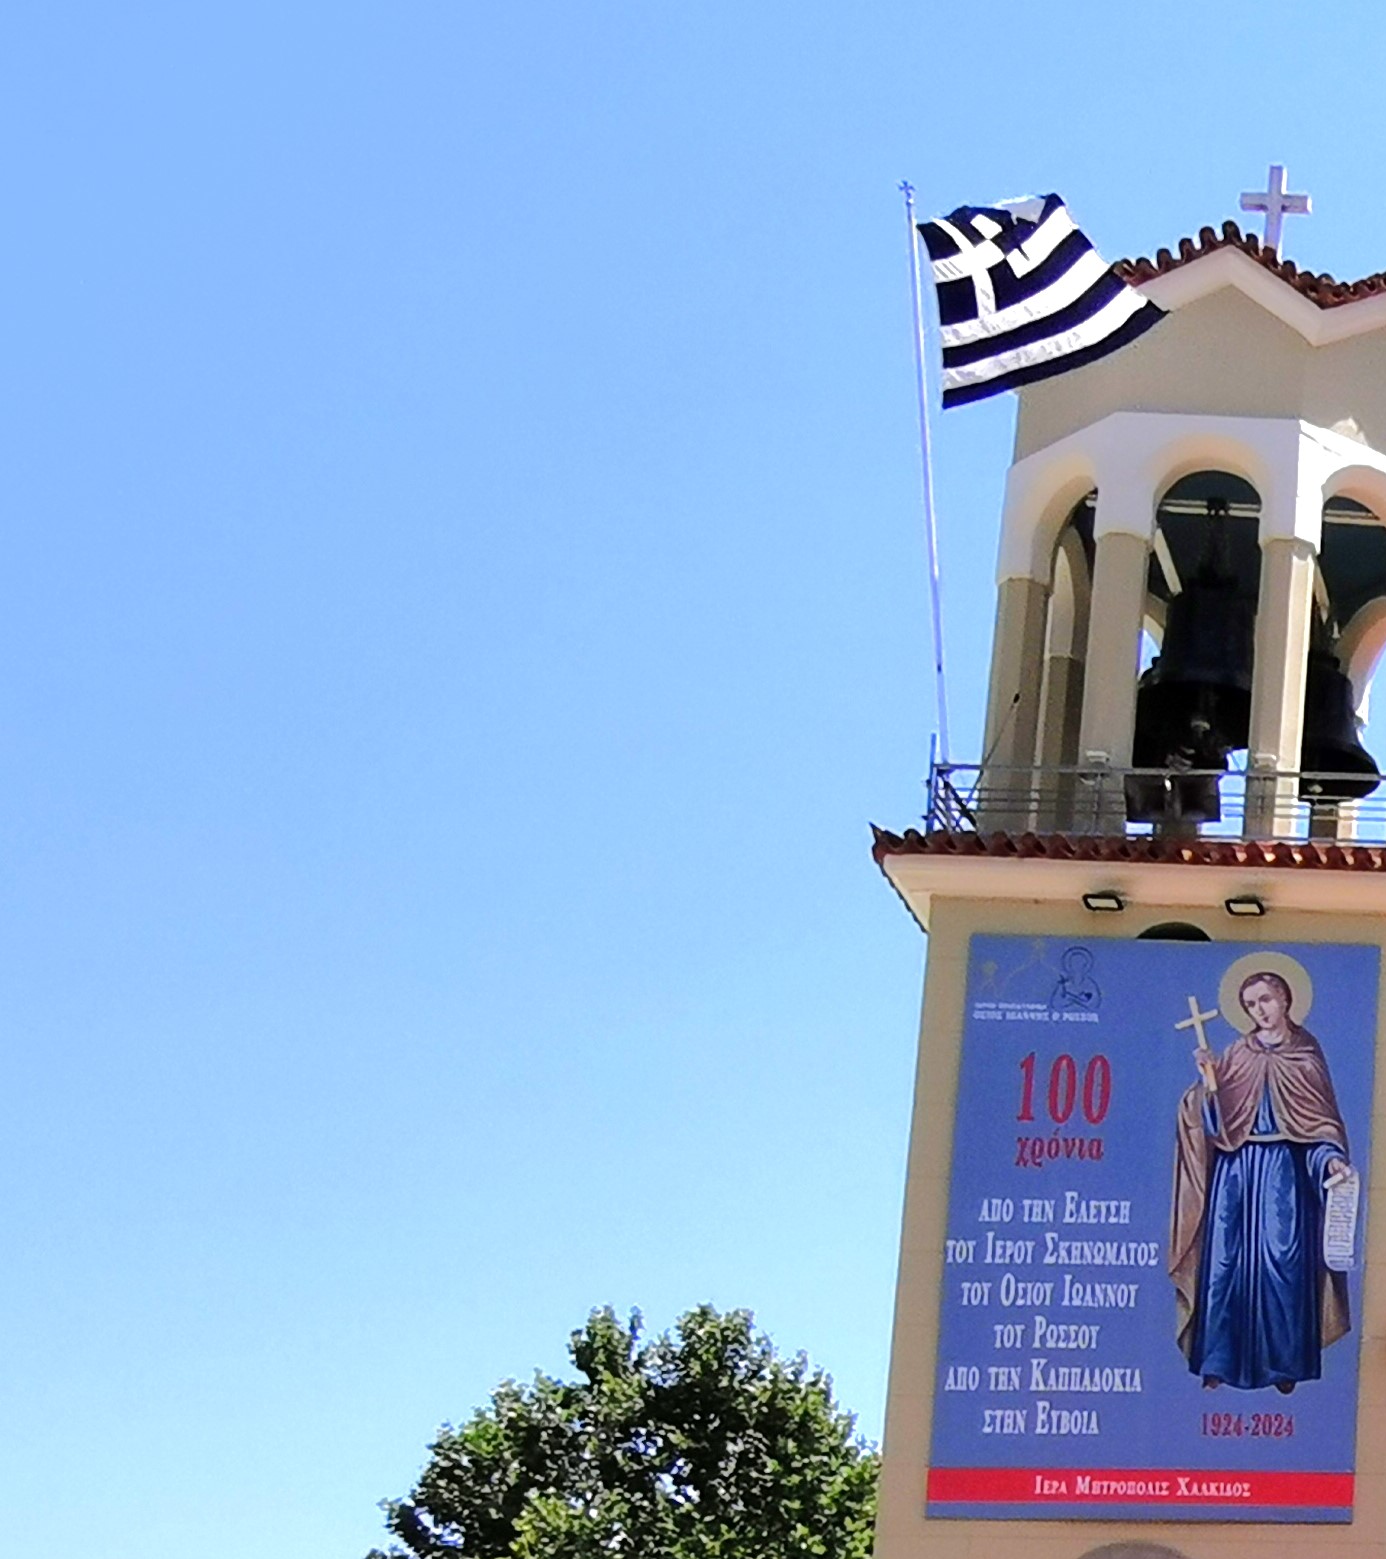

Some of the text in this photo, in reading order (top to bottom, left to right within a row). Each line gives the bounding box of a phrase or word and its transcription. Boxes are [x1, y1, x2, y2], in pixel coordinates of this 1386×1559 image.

[1016, 1052, 1112, 1124] 100
[1015, 1128, 1104, 1168] χρόνια
[978, 1191, 1131, 1224] ΑΠΟ ΤΗΝ ΕΛΕΥΣΗ
[946, 1239, 976, 1263] ΤΟΥ
[984, 1231, 1035, 1264] ΙΕΡΟΥ
[961, 1282, 992, 1306] ΤΟΥ
[1000, 1273, 1054, 1306] ΟΣΙΟΥ
[994, 1315, 1100, 1349] ΤΟΥ ΡΩΣΣΟΥ
[944, 1367, 980, 1390] ΑΠΟ
[988, 1367, 1022, 1391] ΤΗΝ
[982, 1401, 1099, 1435] ΣΤΗΝ ΕΥΒΟΙΑ
[1201, 1412, 1295, 1437] 1924-2024
